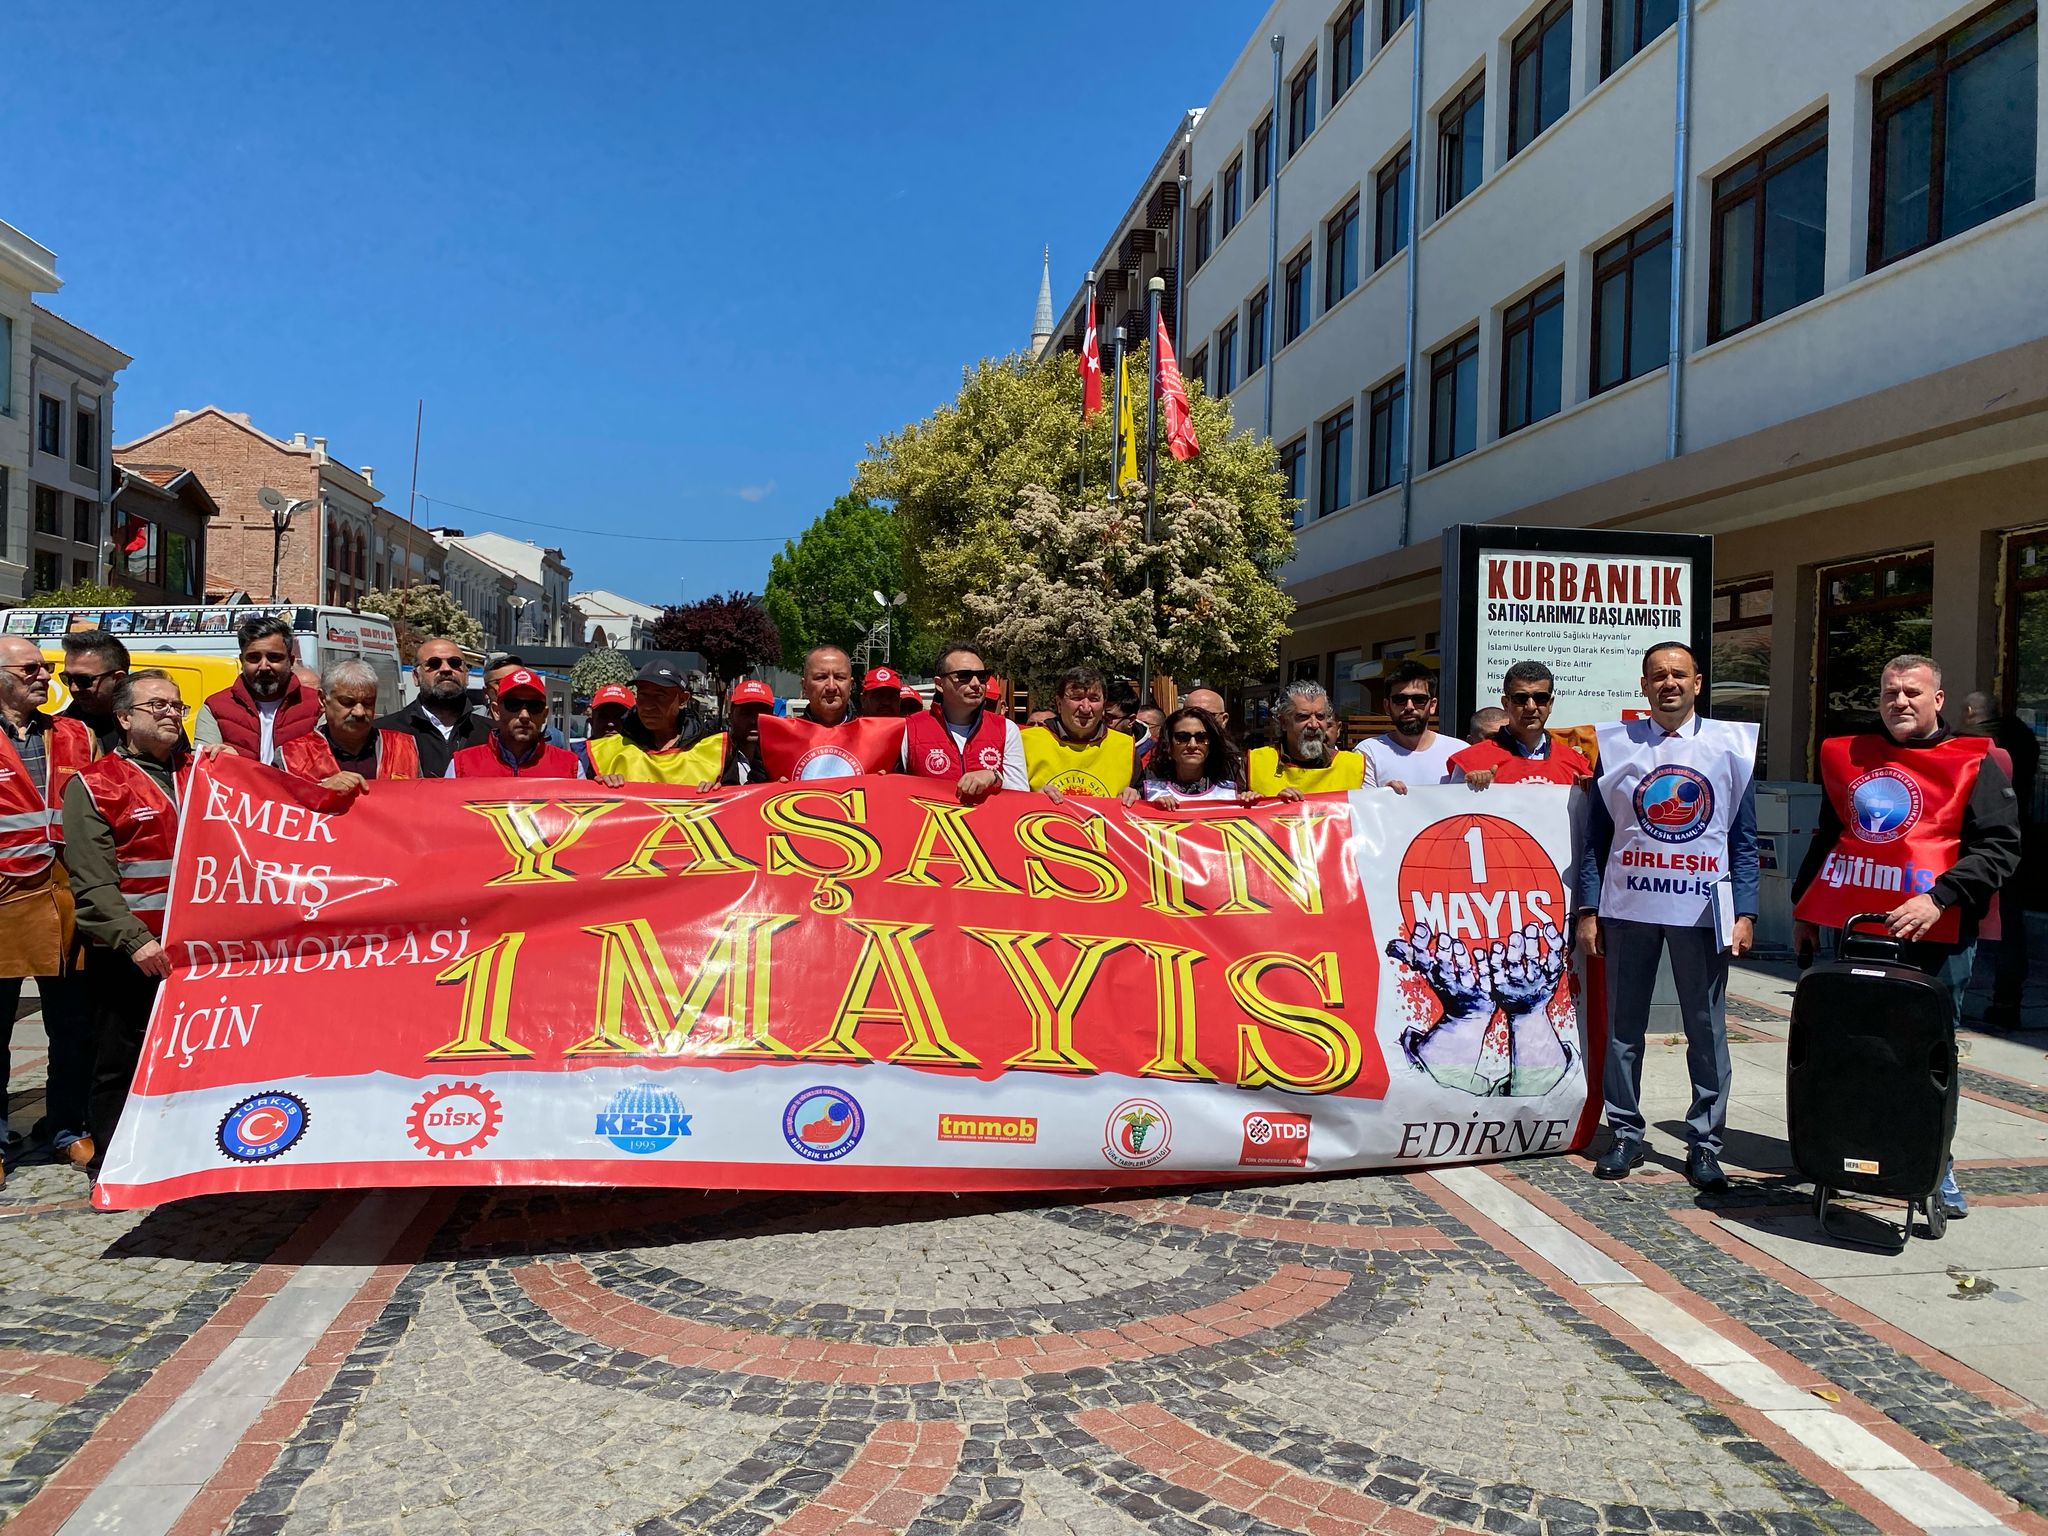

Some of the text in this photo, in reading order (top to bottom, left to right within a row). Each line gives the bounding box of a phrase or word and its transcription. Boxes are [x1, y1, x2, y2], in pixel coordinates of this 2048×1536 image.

[1488, 559, 1683, 606] KURBANLIK
[1488, 603, 1681, 628] SATIŞLARIMIZ BAŞLAMIŞTIR
[1488, 629, 1631, 643] Veteriner Kontrollü Sağlıklı Hayvanlar
[1487, 643, 1512, 652] İslami
[1514, 644, 1546, 653] Usullere
[1548, 645, 1571, 654] Uygun
[1573, 645, 1598, 654] Olarak
[1600, 647, 1625, 655] Kesim
[1487, 658, 1509, 667] Kesip
[1555, 660, 1572, 668] Bize
[1573, 660, 1592, 668] Aittir
[1487, 672, 1504, 680] Hiss
[1577, 689, 1606, 697] Adrese
[1607, 689, 1632, 698] Teslim
[202, 777, 337, 843] EMEK
[462, 787, 1328, 918] YAŞASIN
[1463, 826, 1488, 884] 1
[1622, 846, 1719, 876] BİRLEŞİK
[190, 855, 332, 922] BARIŞ
[1626, 875, 1712, 901] KAMU-İŞ
[1410, 890, 1554, 940] MAYIS
[183, 917, 471, 982] DEMOKRASİ
[425, 912, 1363, 1096] 1 MAYIS
[164, 995, 263, 1068] İÇİN
[427, 1106, 482, 1126] DİSK
[595, 1113, 693, 1136] KESK
[941, 1116, 1035, 1137] tmmob
[1272, 1123, 1308, 1139] TDB
[1393, 1110, 1570, 1160] EDİRNE
[237, 1142, 280, 1156] 1952
[630, 1140, 657, 1151] 1995
[790, 1137, 820, 1159] BİRLEŞİK
